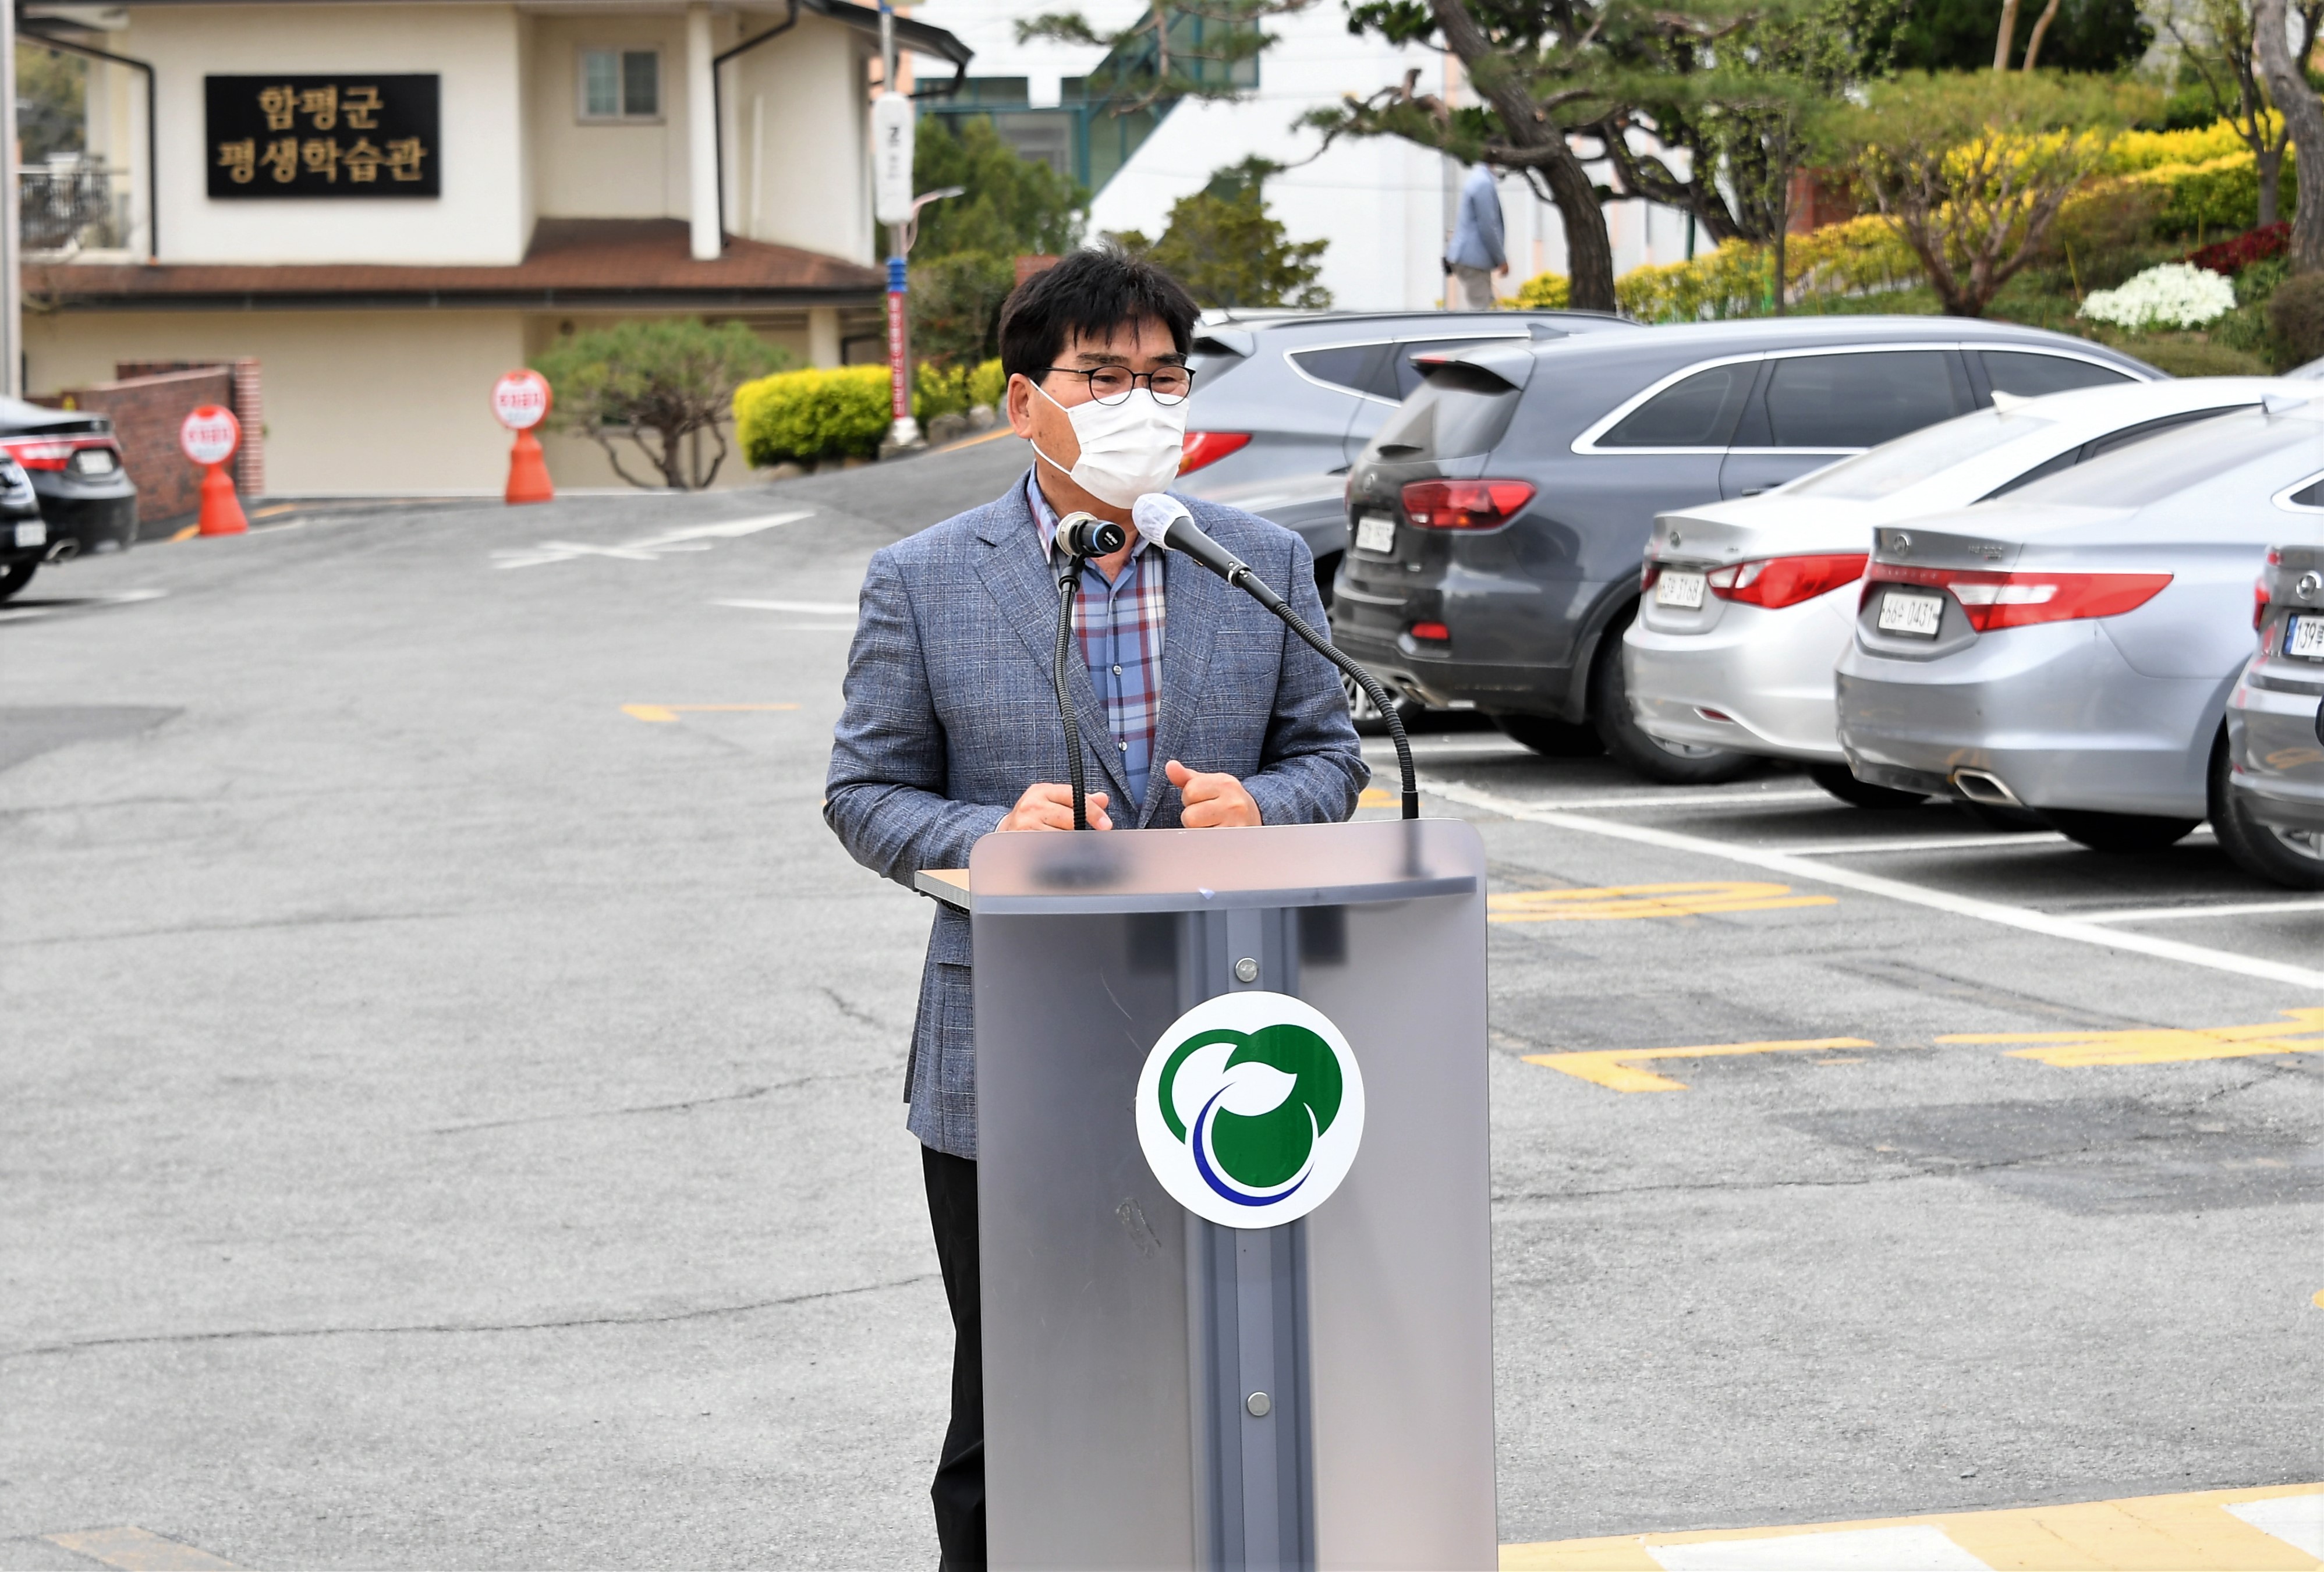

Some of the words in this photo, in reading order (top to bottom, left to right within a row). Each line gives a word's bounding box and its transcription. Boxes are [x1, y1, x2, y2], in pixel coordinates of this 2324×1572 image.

[258, 85, 384, 131] 함평군
[218, 137, 429, 183] 평생학습관
[1907, 601, 1933, 628] 0431
